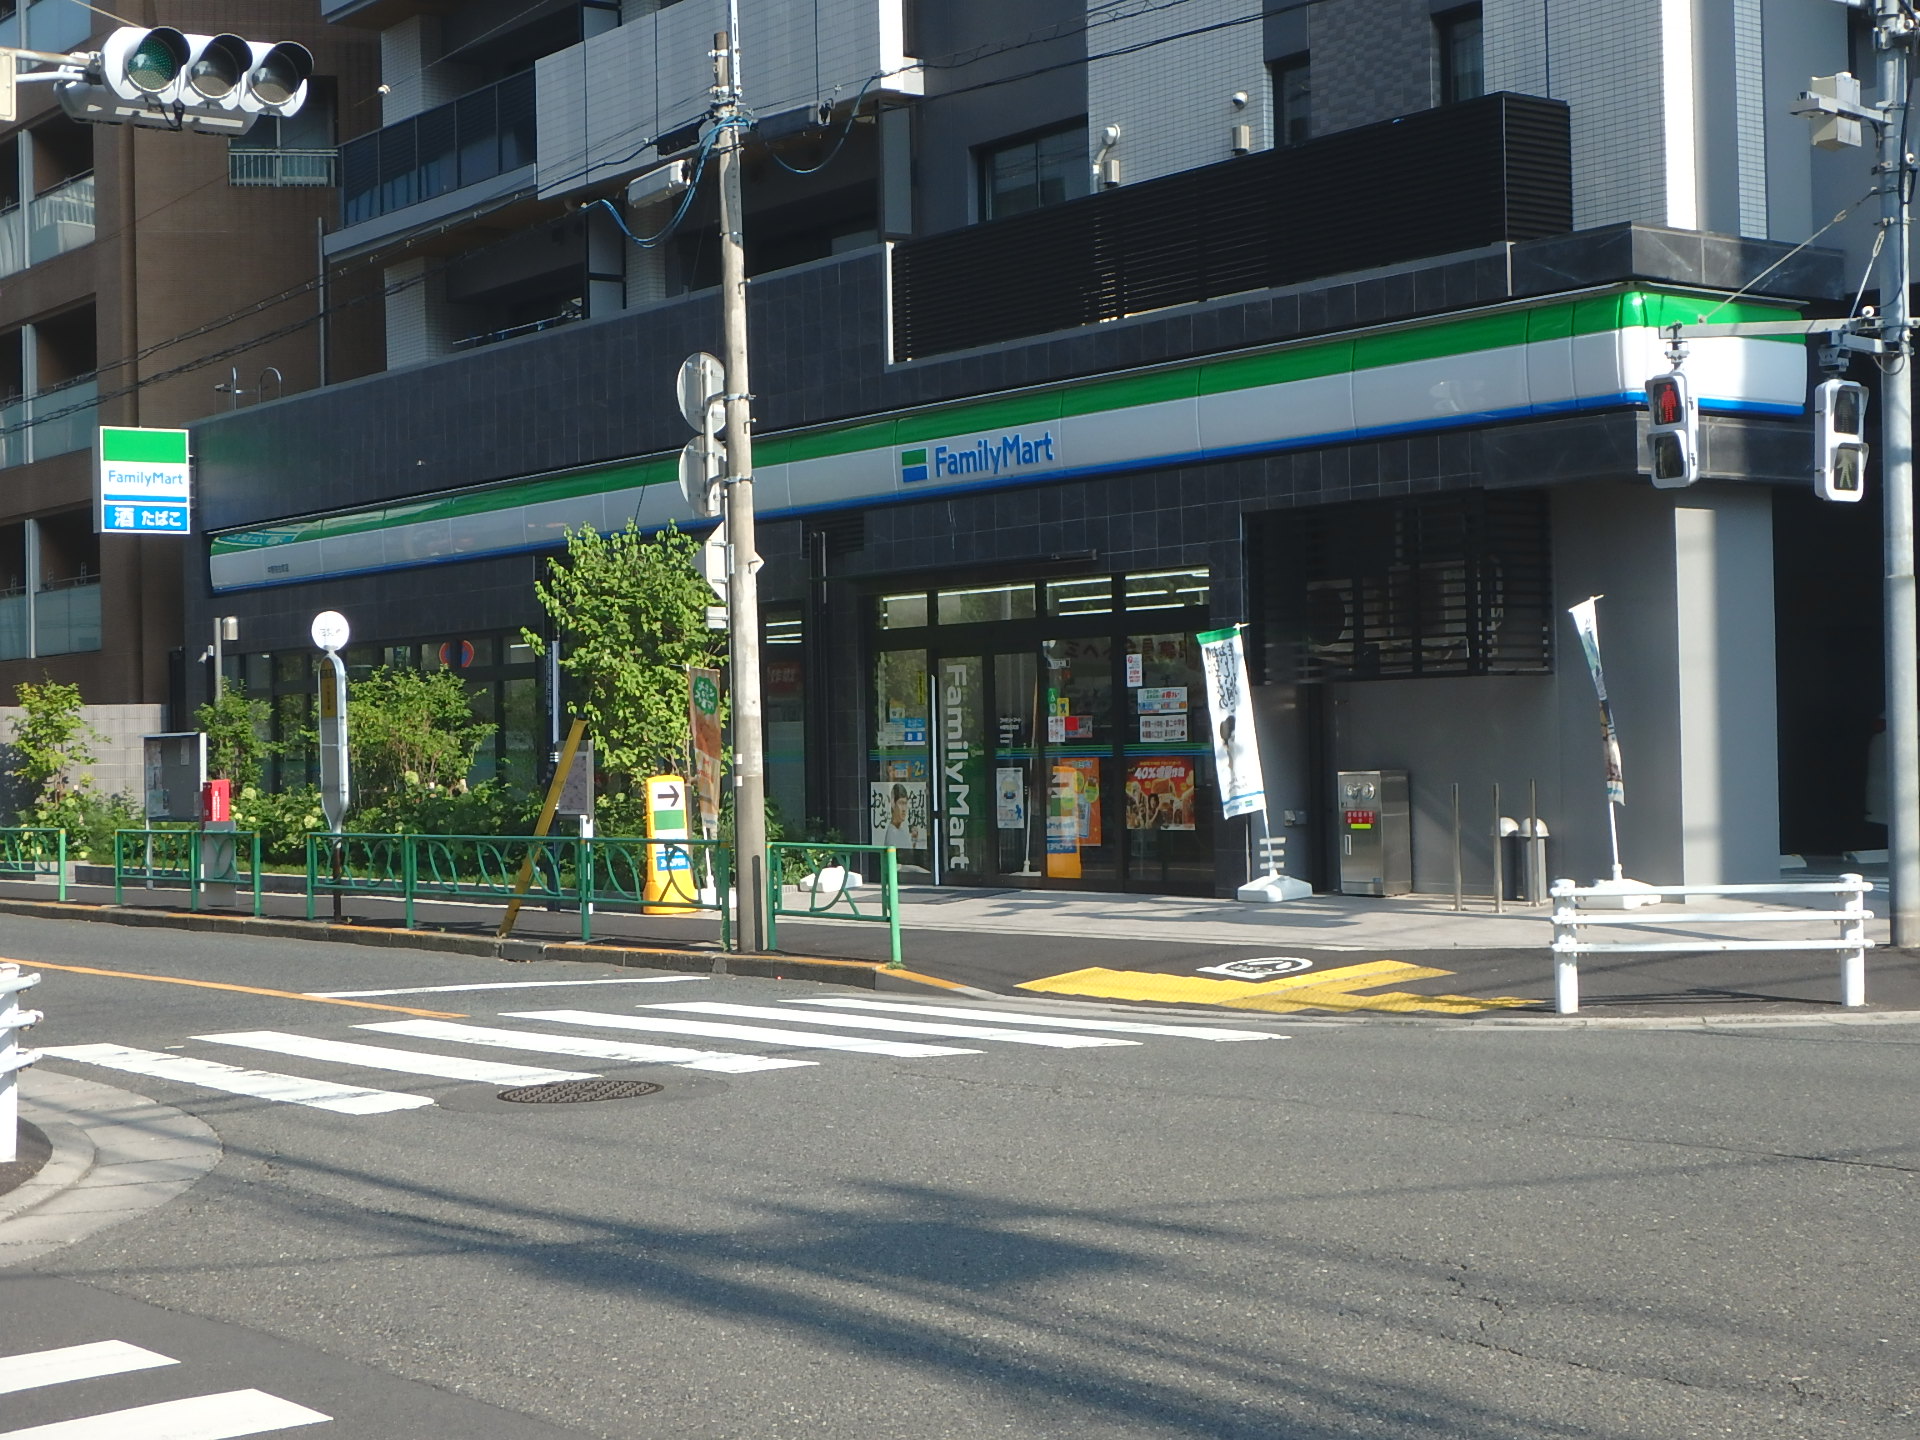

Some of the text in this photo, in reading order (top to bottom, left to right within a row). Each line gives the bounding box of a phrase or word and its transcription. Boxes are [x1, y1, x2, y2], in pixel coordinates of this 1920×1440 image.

[935, 432, 1054, 478] FamilyMart
[108, 469, 183, 487] FamilyMart
[114, 506, 182, 528] 酒 たばこ
[946, 664, 971, 870] FamilyMart
